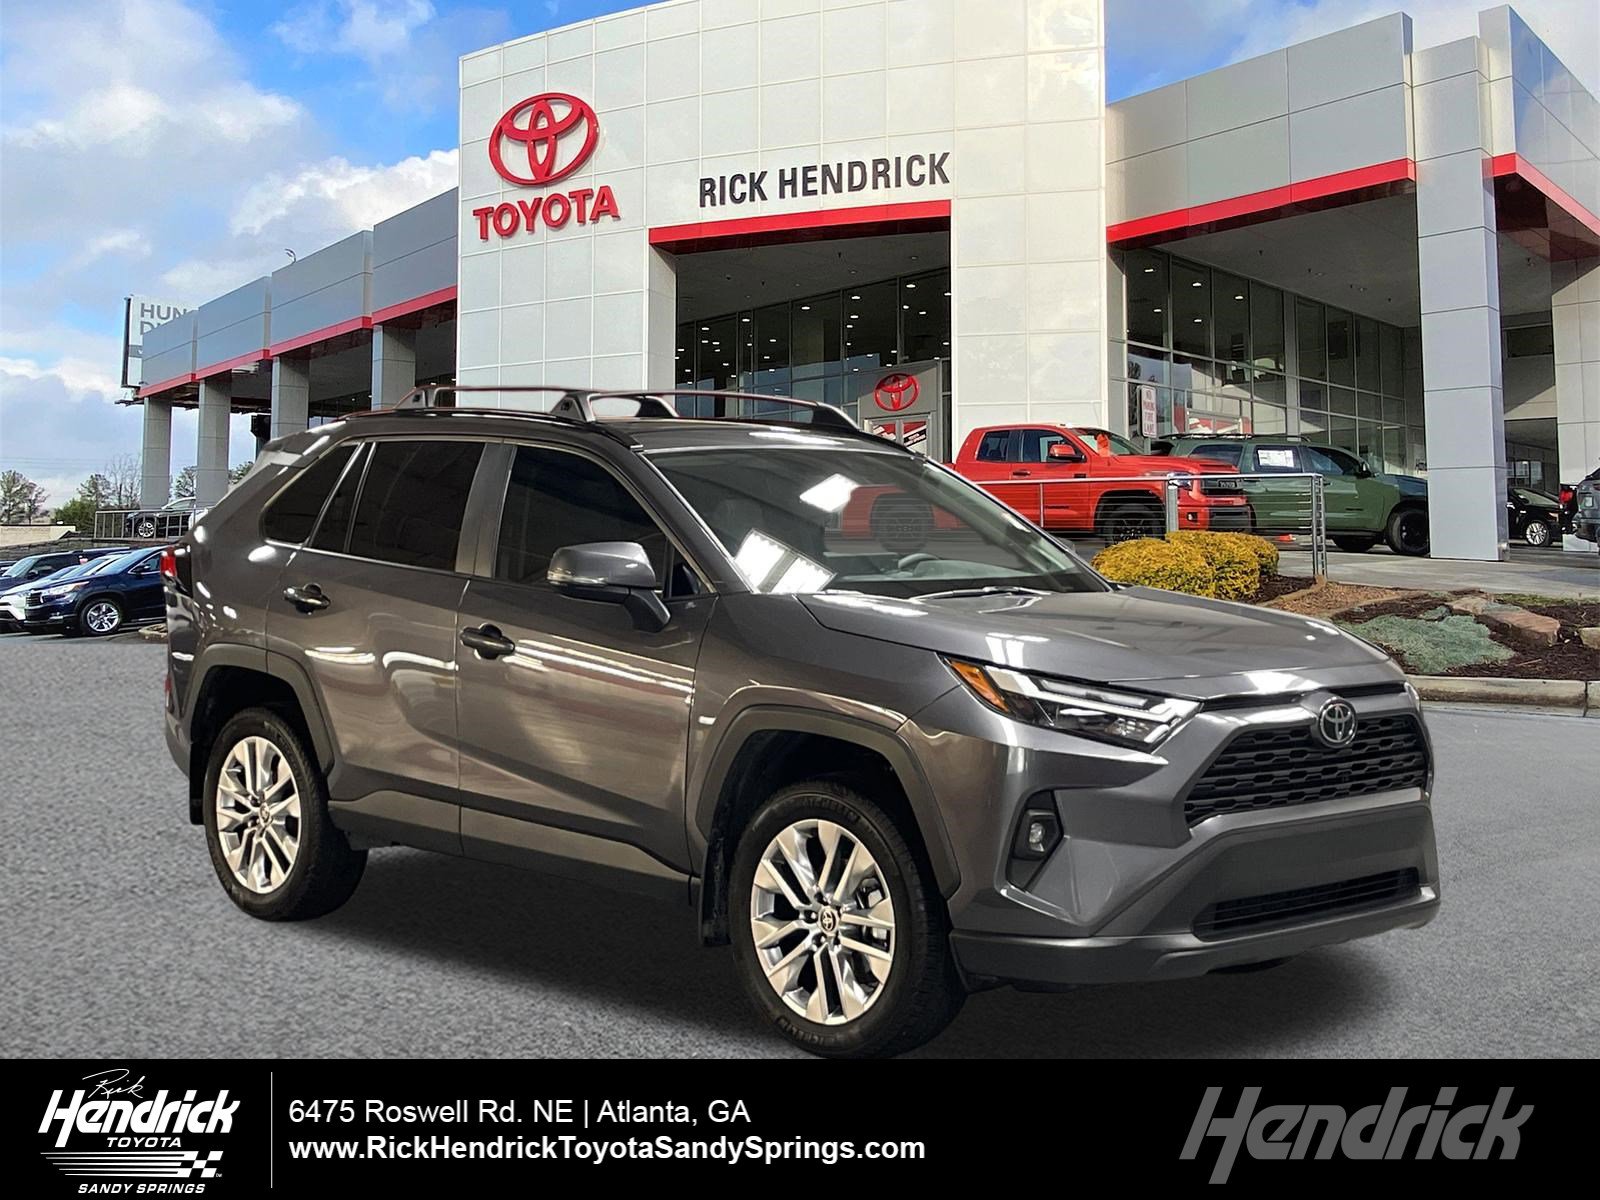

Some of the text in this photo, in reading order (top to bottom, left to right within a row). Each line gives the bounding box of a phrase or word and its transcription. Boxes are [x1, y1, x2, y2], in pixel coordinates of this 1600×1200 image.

[699, 152, 951, 209] RICK HENDRICK
[472, 185, 621, 240] TOYOTA
